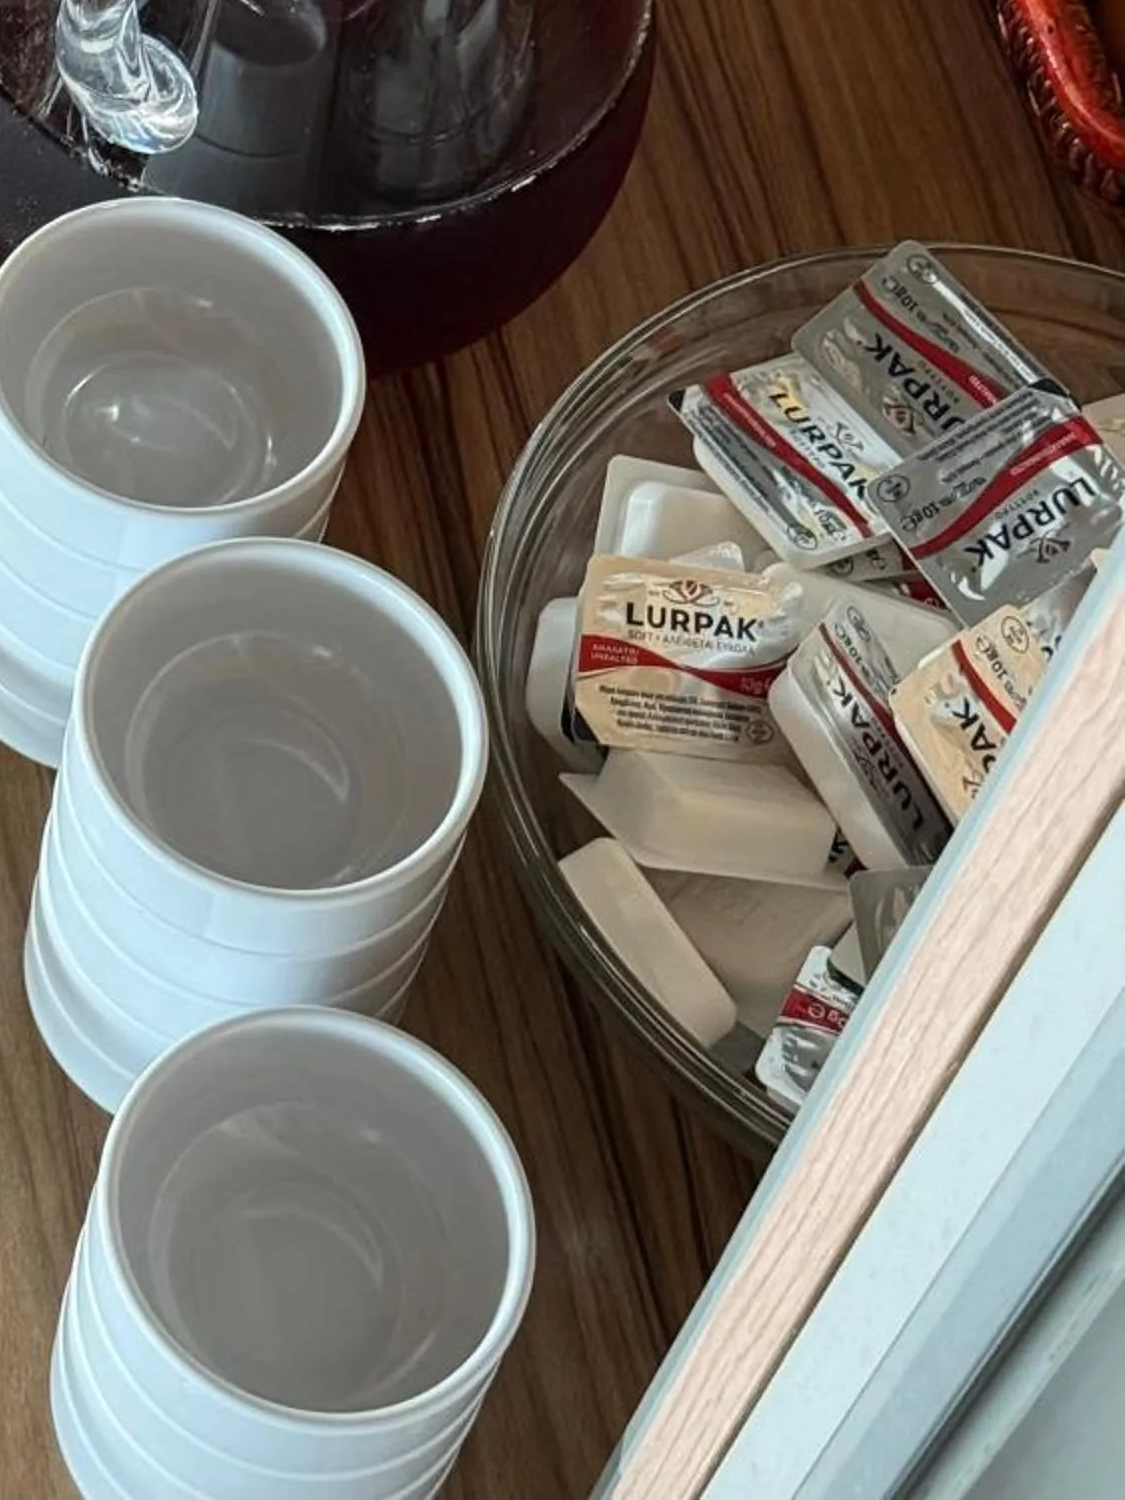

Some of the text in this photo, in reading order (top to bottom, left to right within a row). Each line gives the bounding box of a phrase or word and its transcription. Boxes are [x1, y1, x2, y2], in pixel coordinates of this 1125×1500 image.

[865, 332, 966, 430] URPAK
[769, 387, 868, 500] LURPAK
[964, 477, 1096, 566] LURPAK
[626, 602, 757, 642] LURPAK
[831, 678, 925, 832] LURPAK
